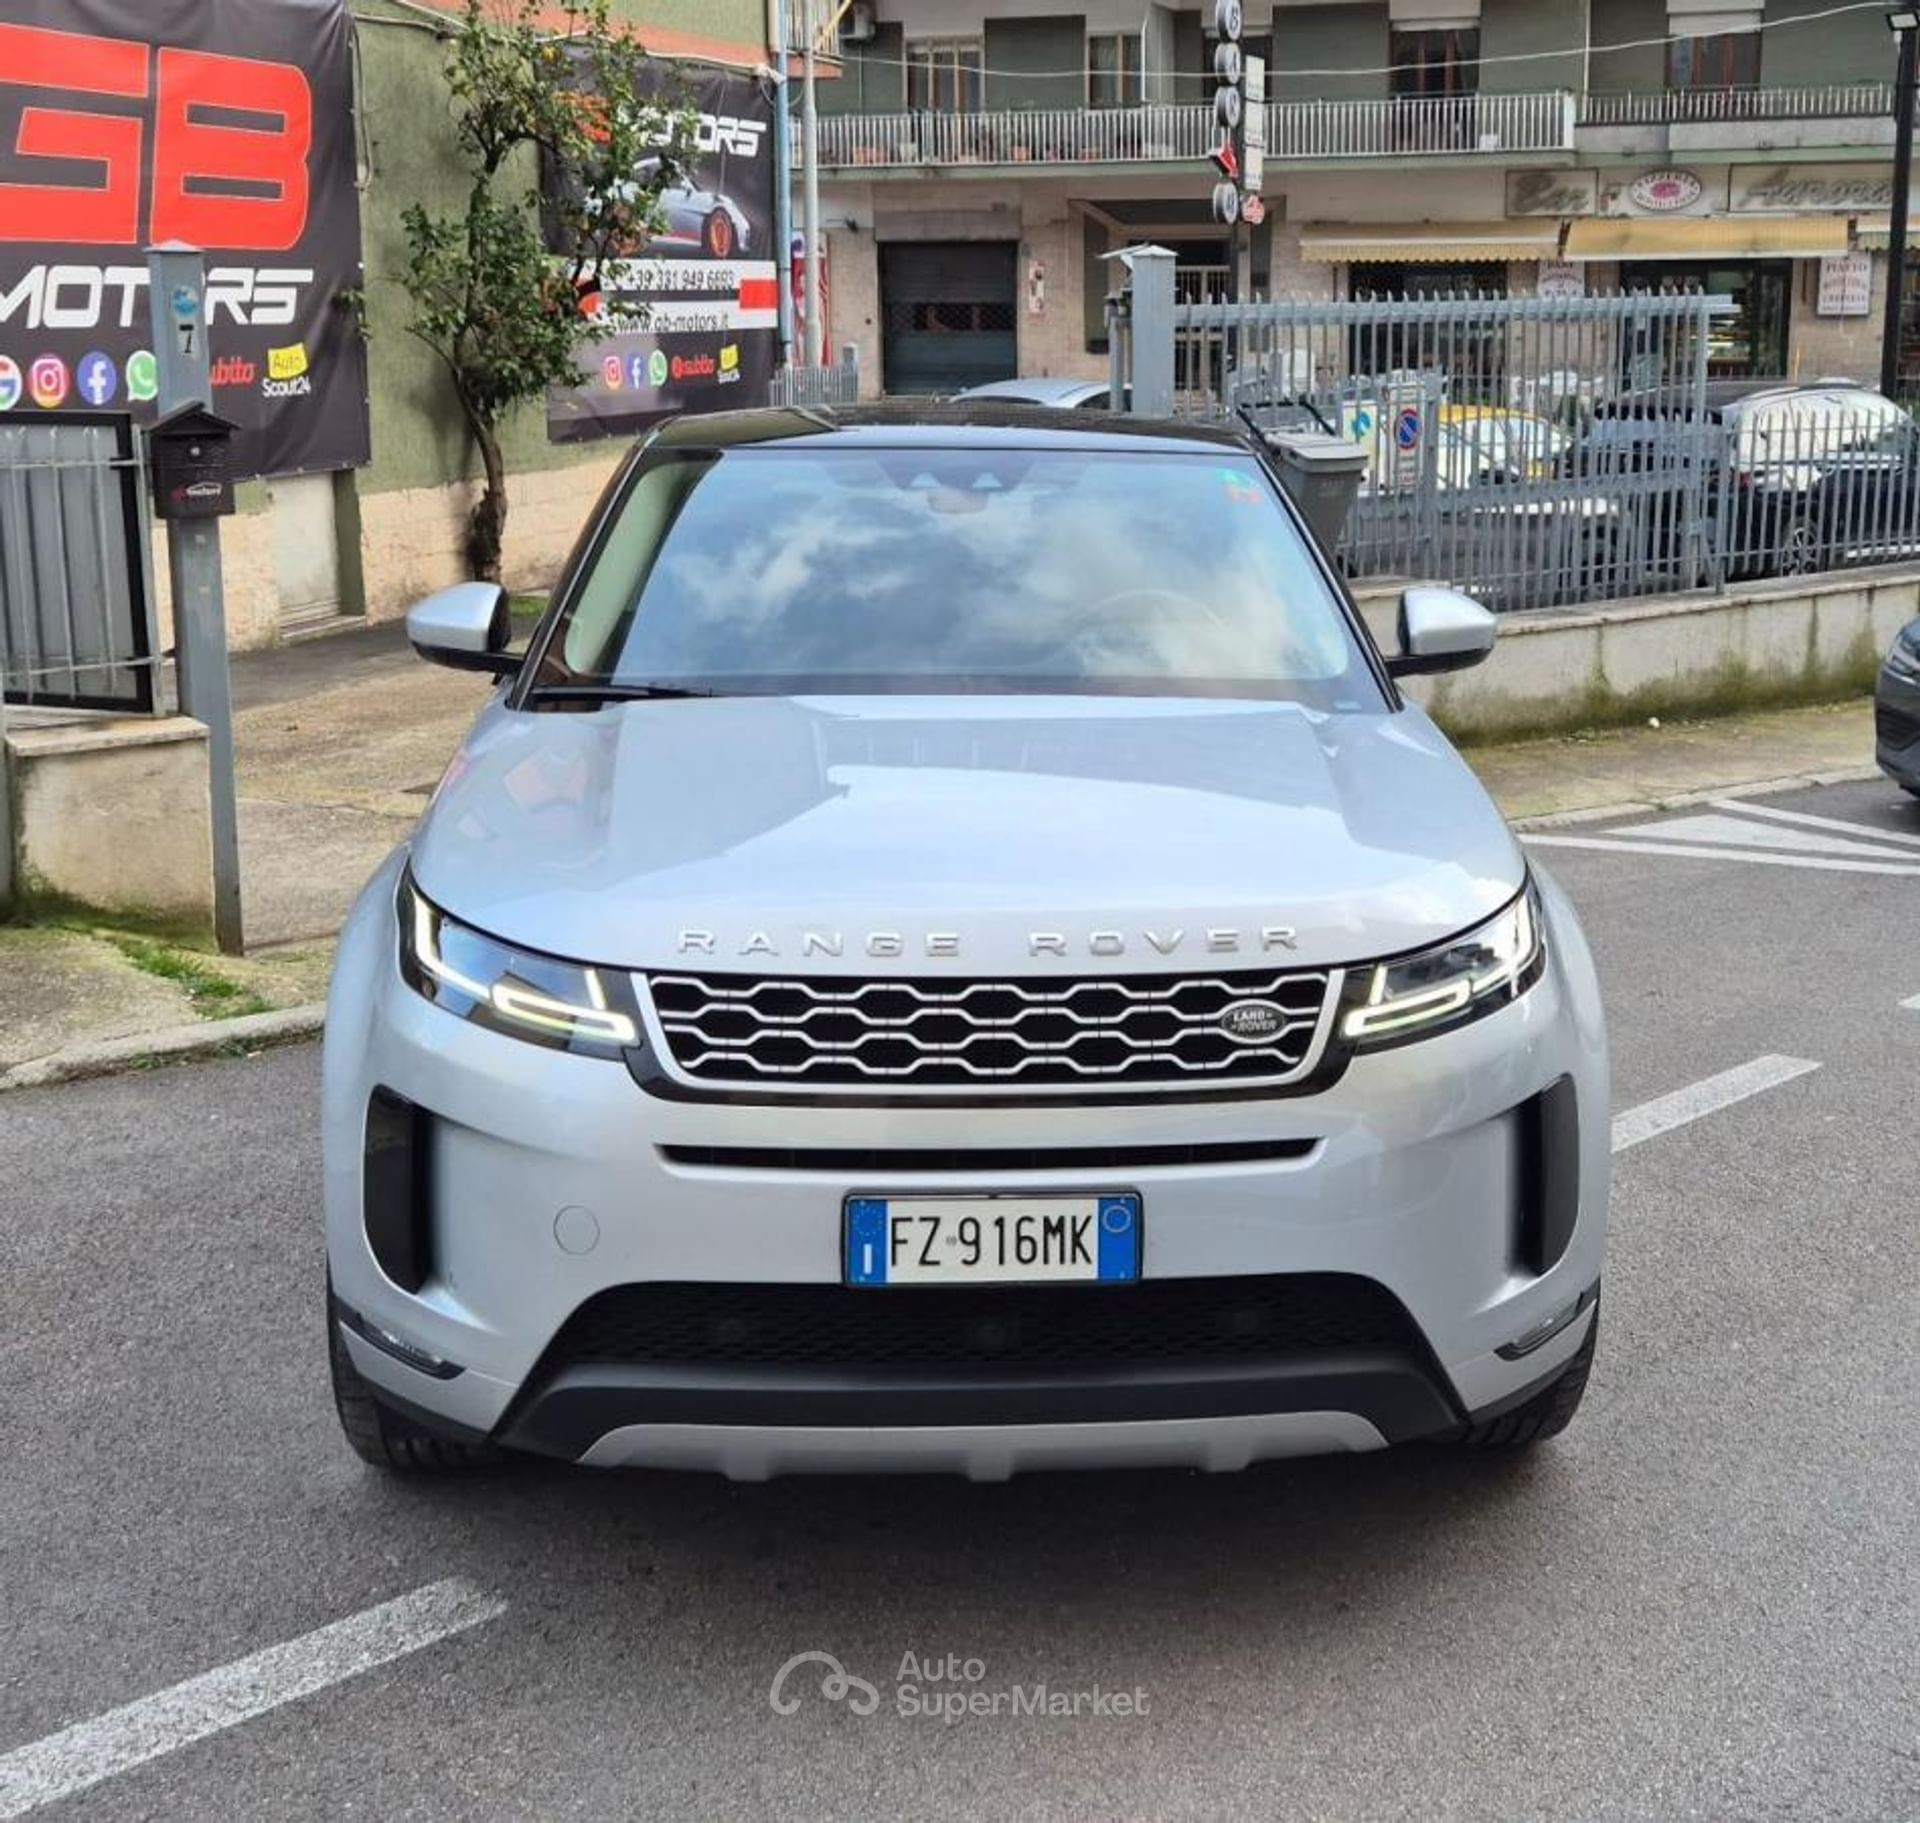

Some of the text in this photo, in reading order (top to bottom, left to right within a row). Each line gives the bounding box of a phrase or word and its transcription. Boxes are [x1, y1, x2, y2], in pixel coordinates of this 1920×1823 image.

[261, 376, 311, 398] Scout24
[676, 926, 1299, 958] RANGE ROVER
[890, 1215, 1093, 1267] FZ 916MK
